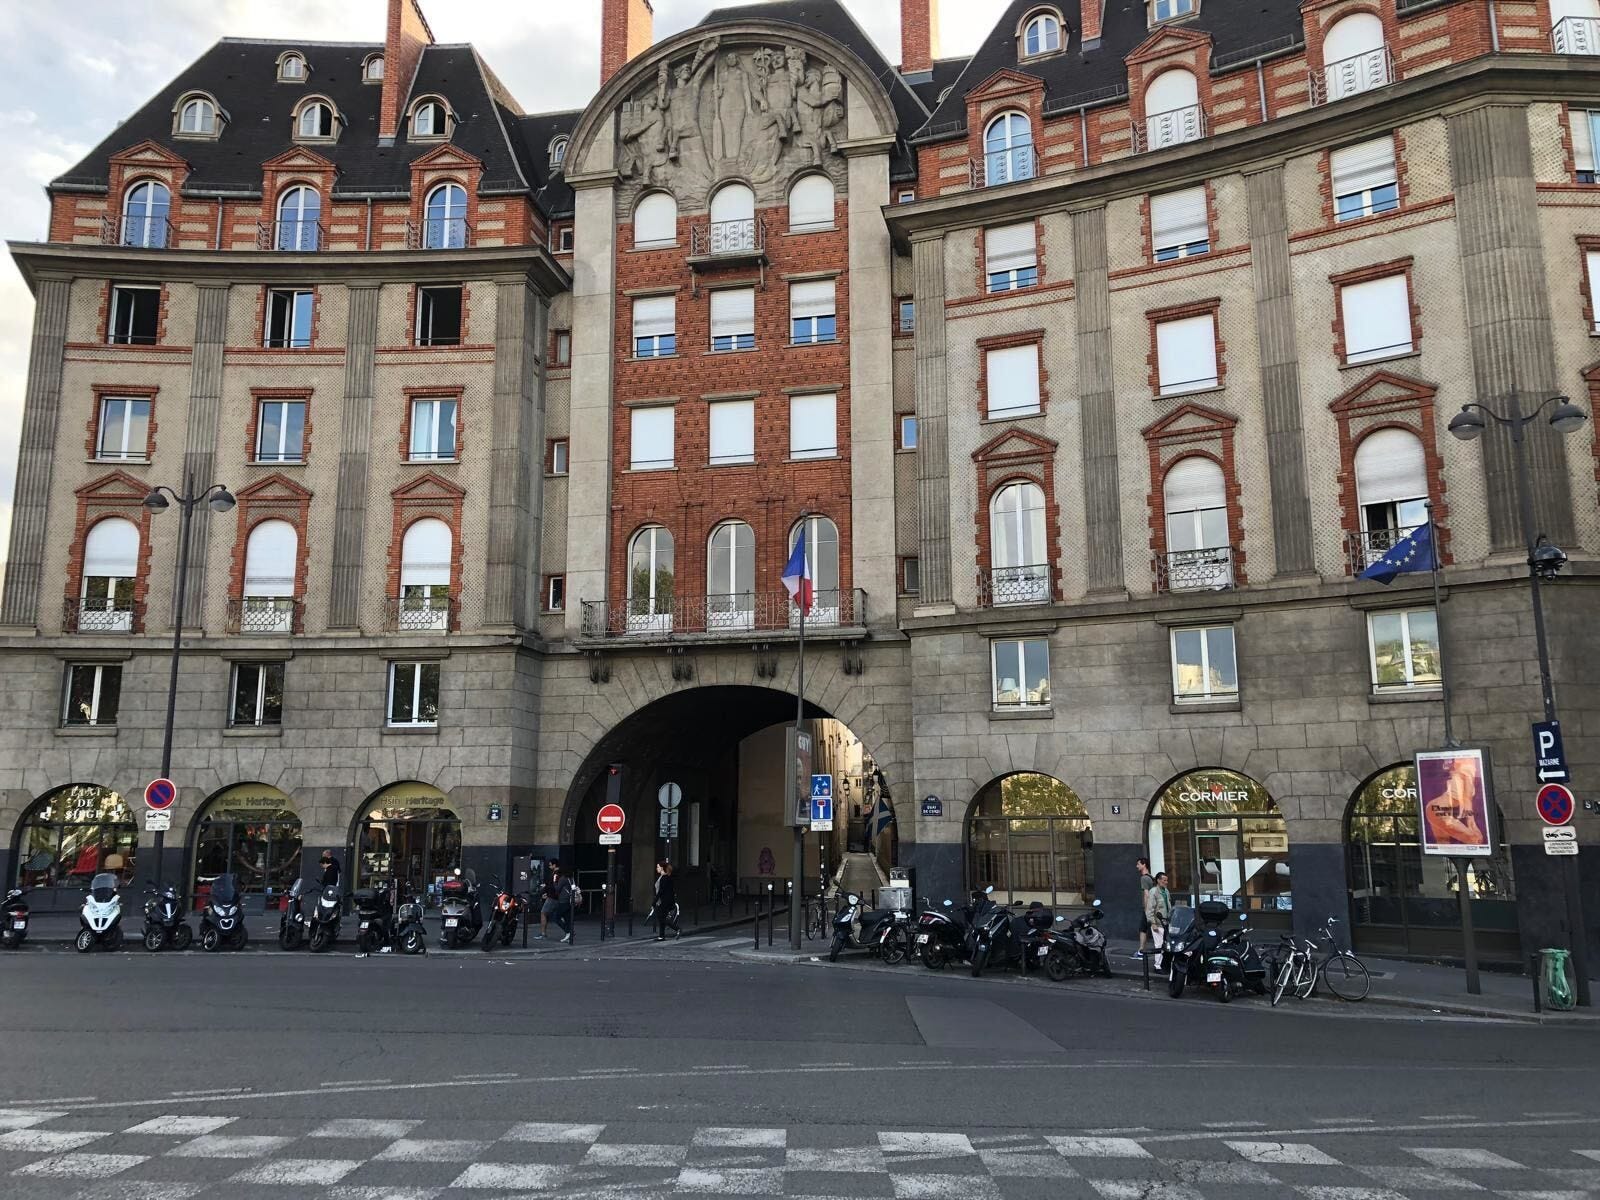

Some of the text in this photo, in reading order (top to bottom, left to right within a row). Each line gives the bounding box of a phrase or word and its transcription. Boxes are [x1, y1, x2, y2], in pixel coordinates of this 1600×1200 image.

[1538, 730, 1554, 758] P
[1538, 758, 1560, 767] MAZARINE
[1179, 791, 1249, 802] CORMIER
[1381, 788, 1417, 799] COR
[77, 798, 94, 808] DE
[245, 797, 287, 808] Heritage
[380, 796, 444, 807] Hsin Heritage
